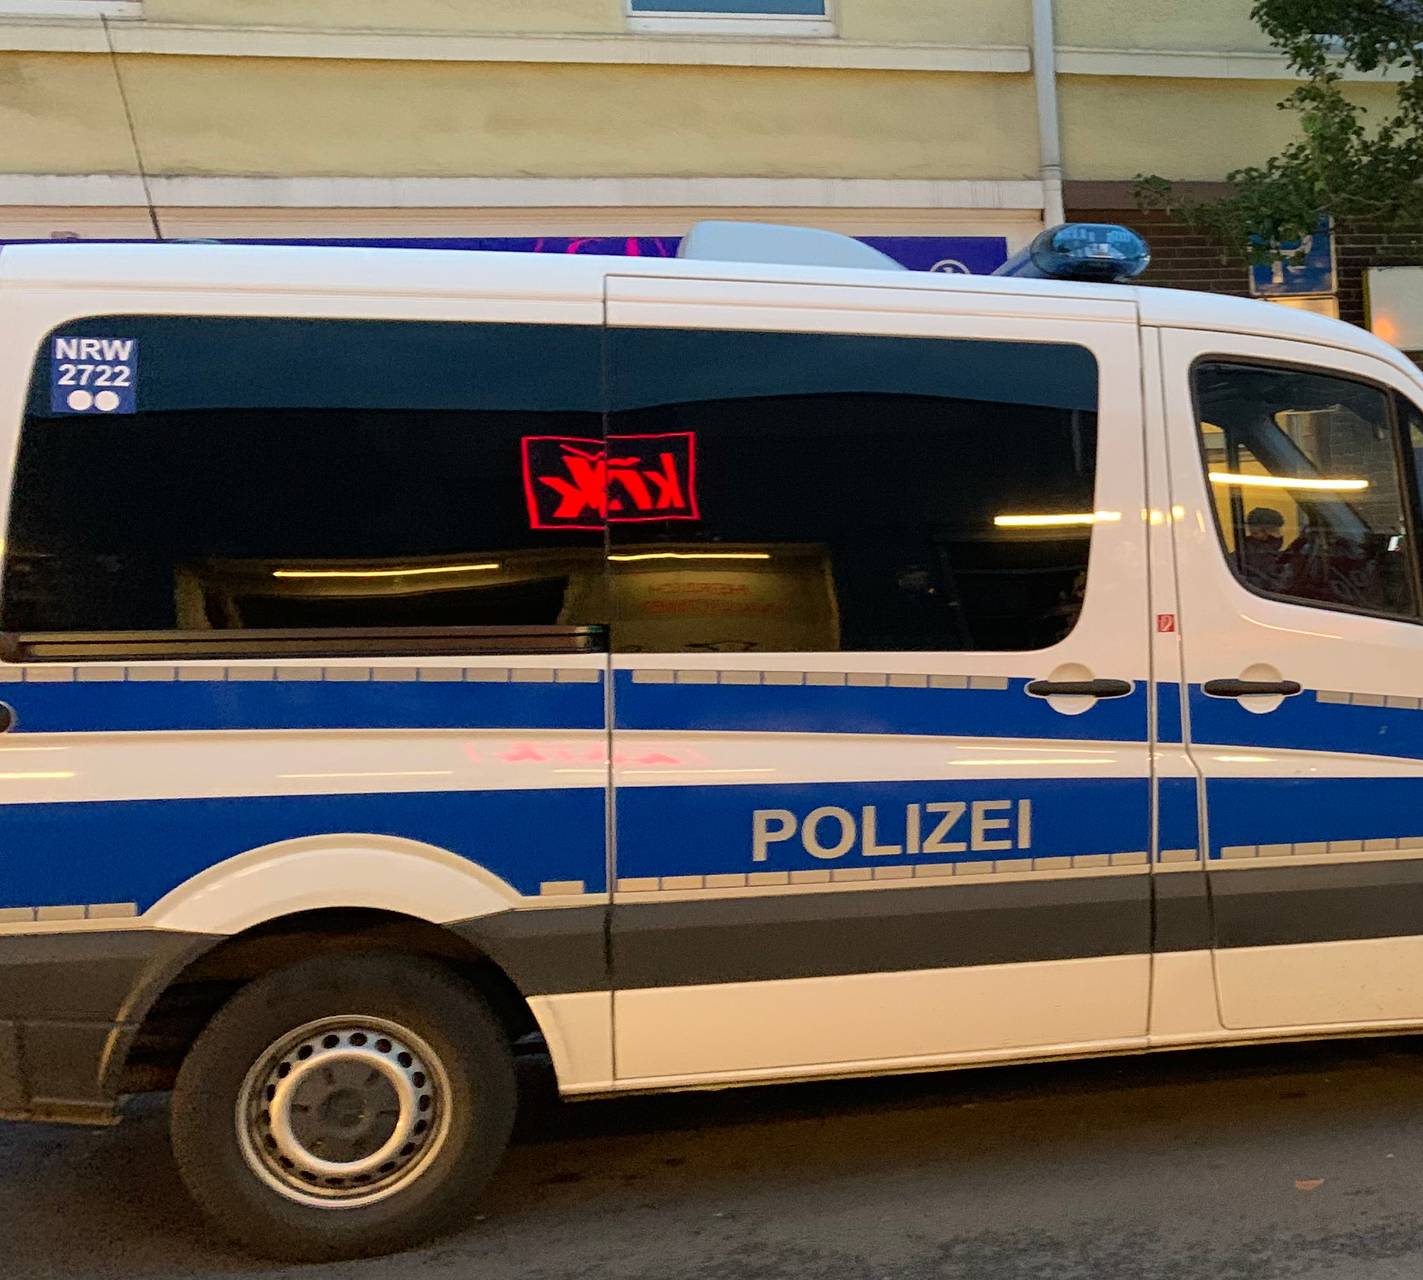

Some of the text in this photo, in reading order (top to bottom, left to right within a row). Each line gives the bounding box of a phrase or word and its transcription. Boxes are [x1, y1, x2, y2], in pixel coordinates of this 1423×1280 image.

[55, 338, 133, 361] NRW
[57, 363, 131, 387] 2722
[752, 799, 1032, 862] POLIZEI
